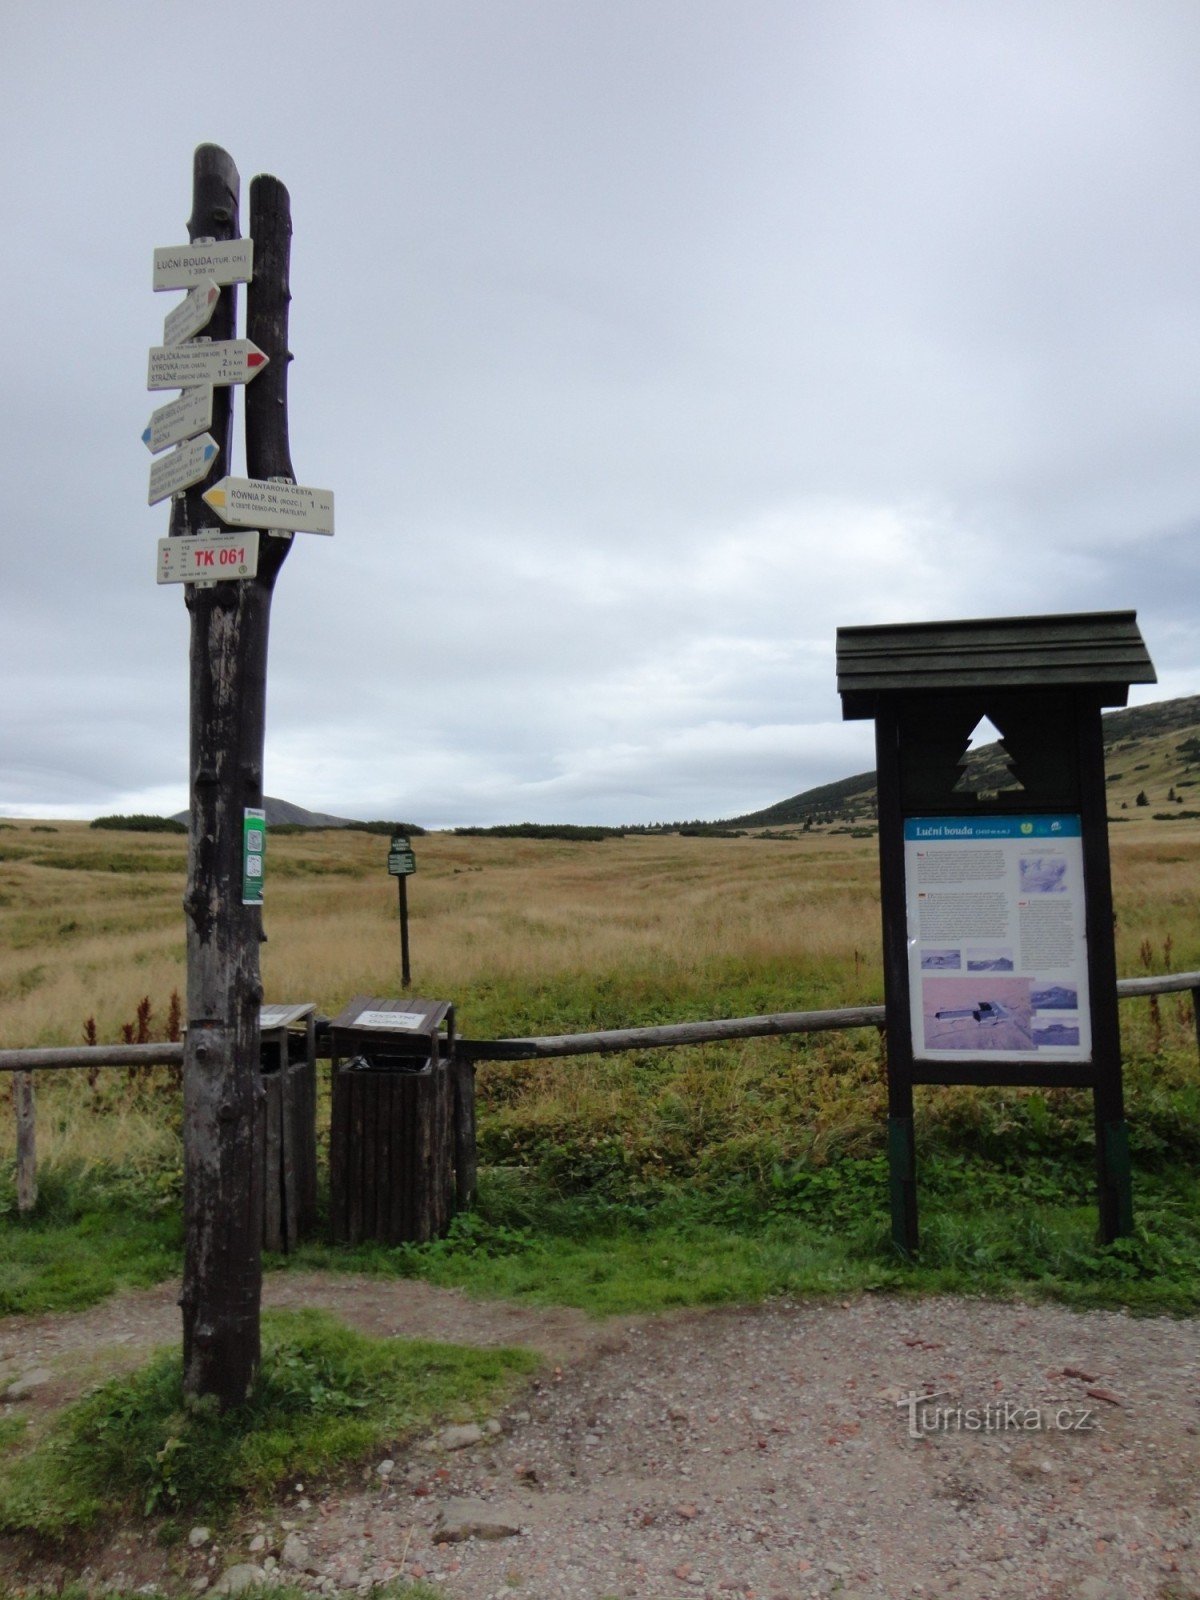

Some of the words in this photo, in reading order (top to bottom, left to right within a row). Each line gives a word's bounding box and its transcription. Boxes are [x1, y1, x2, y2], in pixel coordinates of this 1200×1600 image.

[183, 256, 212, 267] BOUDA
[291, 488, 313, 496] CESTA
[310, 500, 315, 509] 1
[194, 550, 215, 567] TK
[219, 547, 245, 565] 061
[916, 826, 942, 836] Luční
[944, 826, 973, 836] bouda
